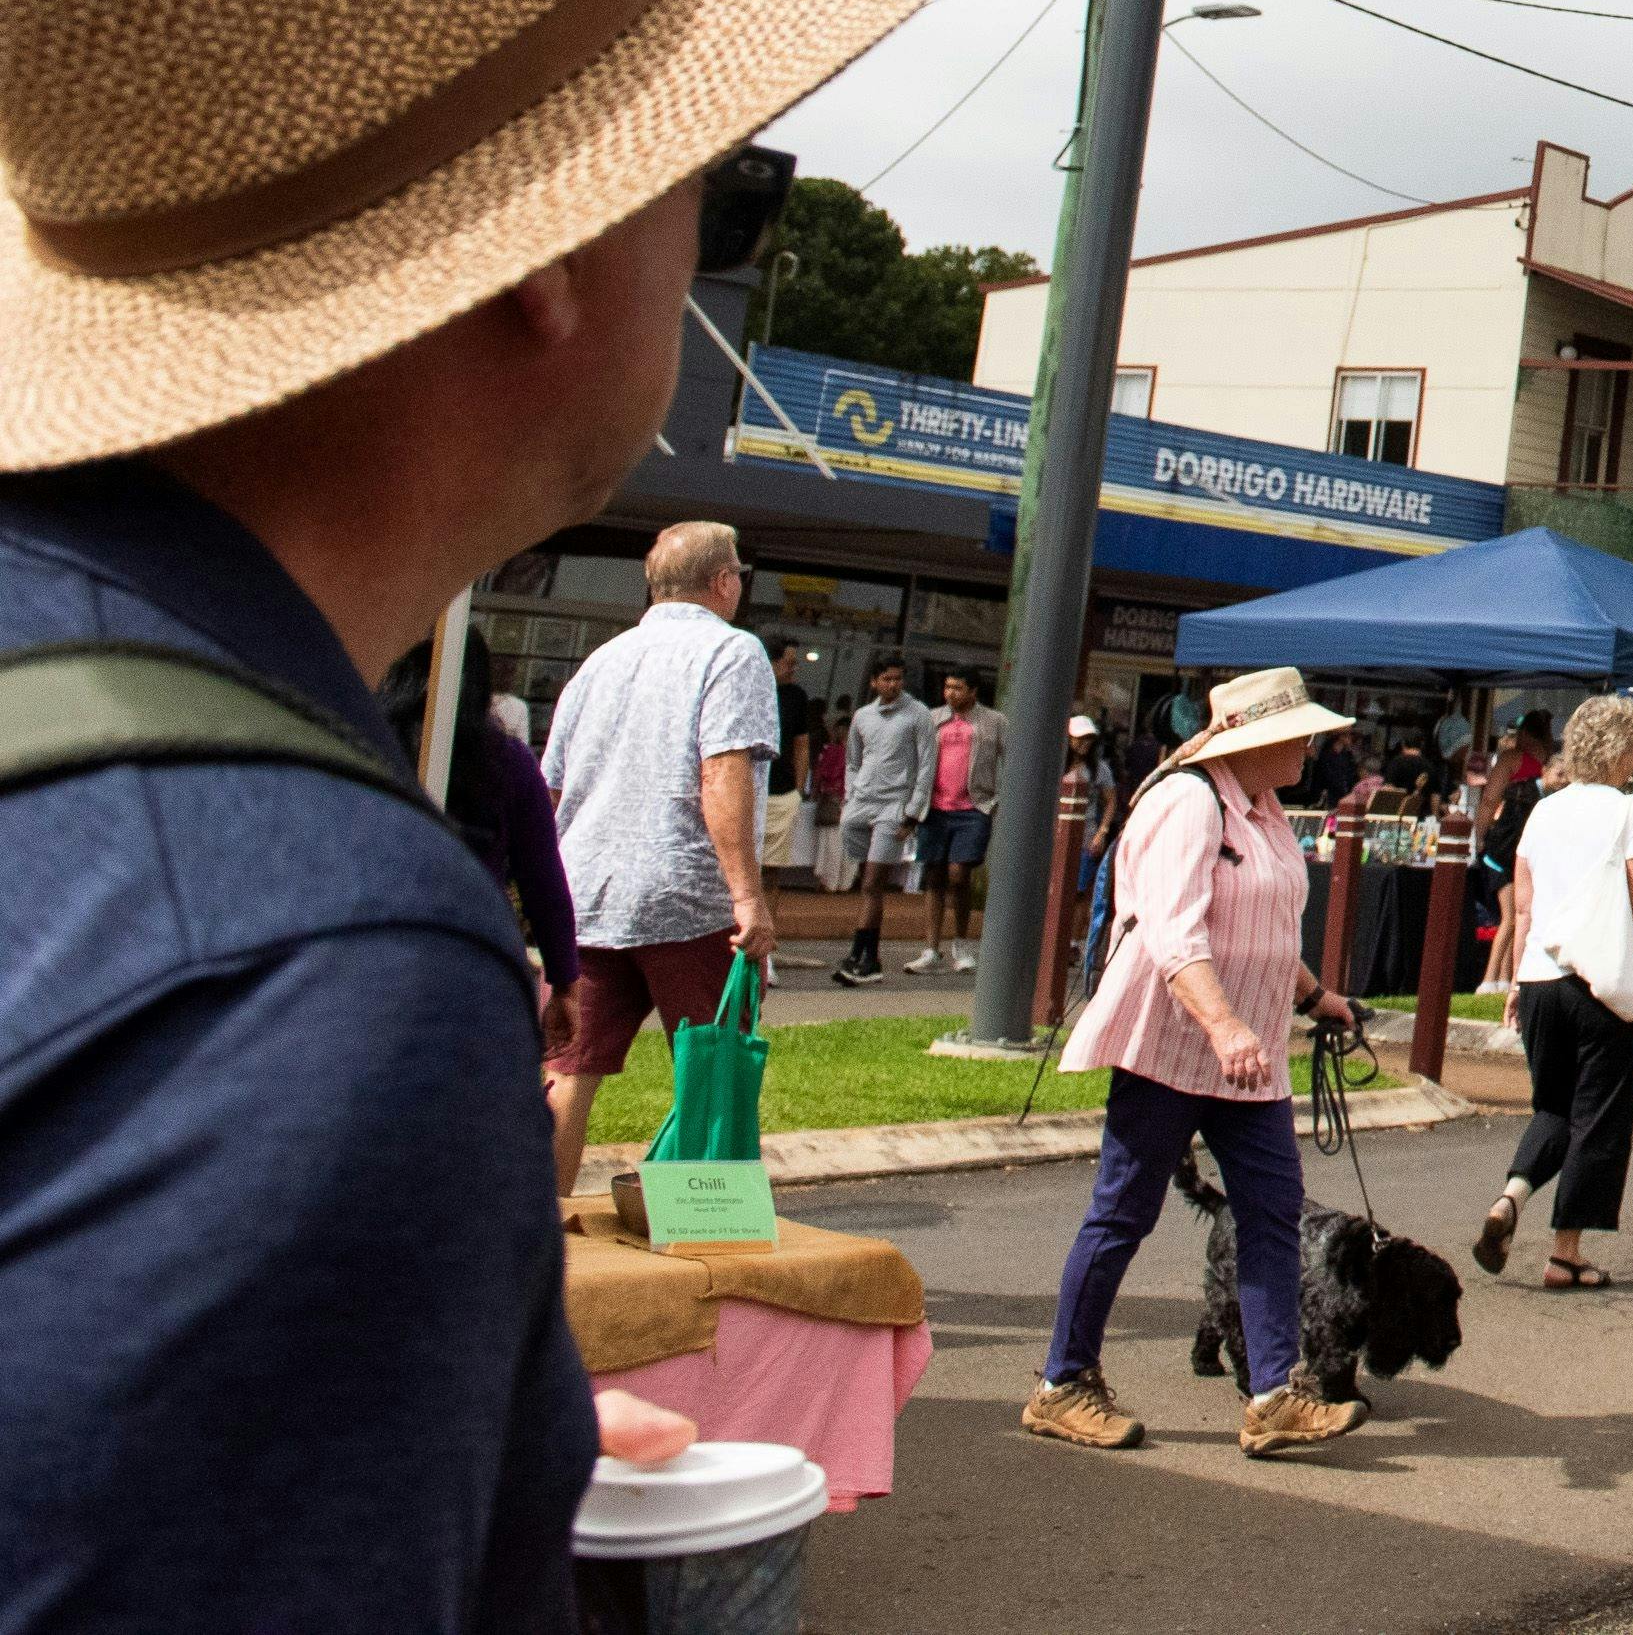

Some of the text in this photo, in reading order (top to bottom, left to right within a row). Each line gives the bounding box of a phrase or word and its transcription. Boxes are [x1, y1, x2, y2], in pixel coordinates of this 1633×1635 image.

[901, 400, 1029, 449] THRIFTY-LIN
[1154, 447, 1434, 525] DORRIGO HARDWARE
[1113, 605, 1176, 630] DORRIG
[688, 1177, 726, 1191] Chilli
